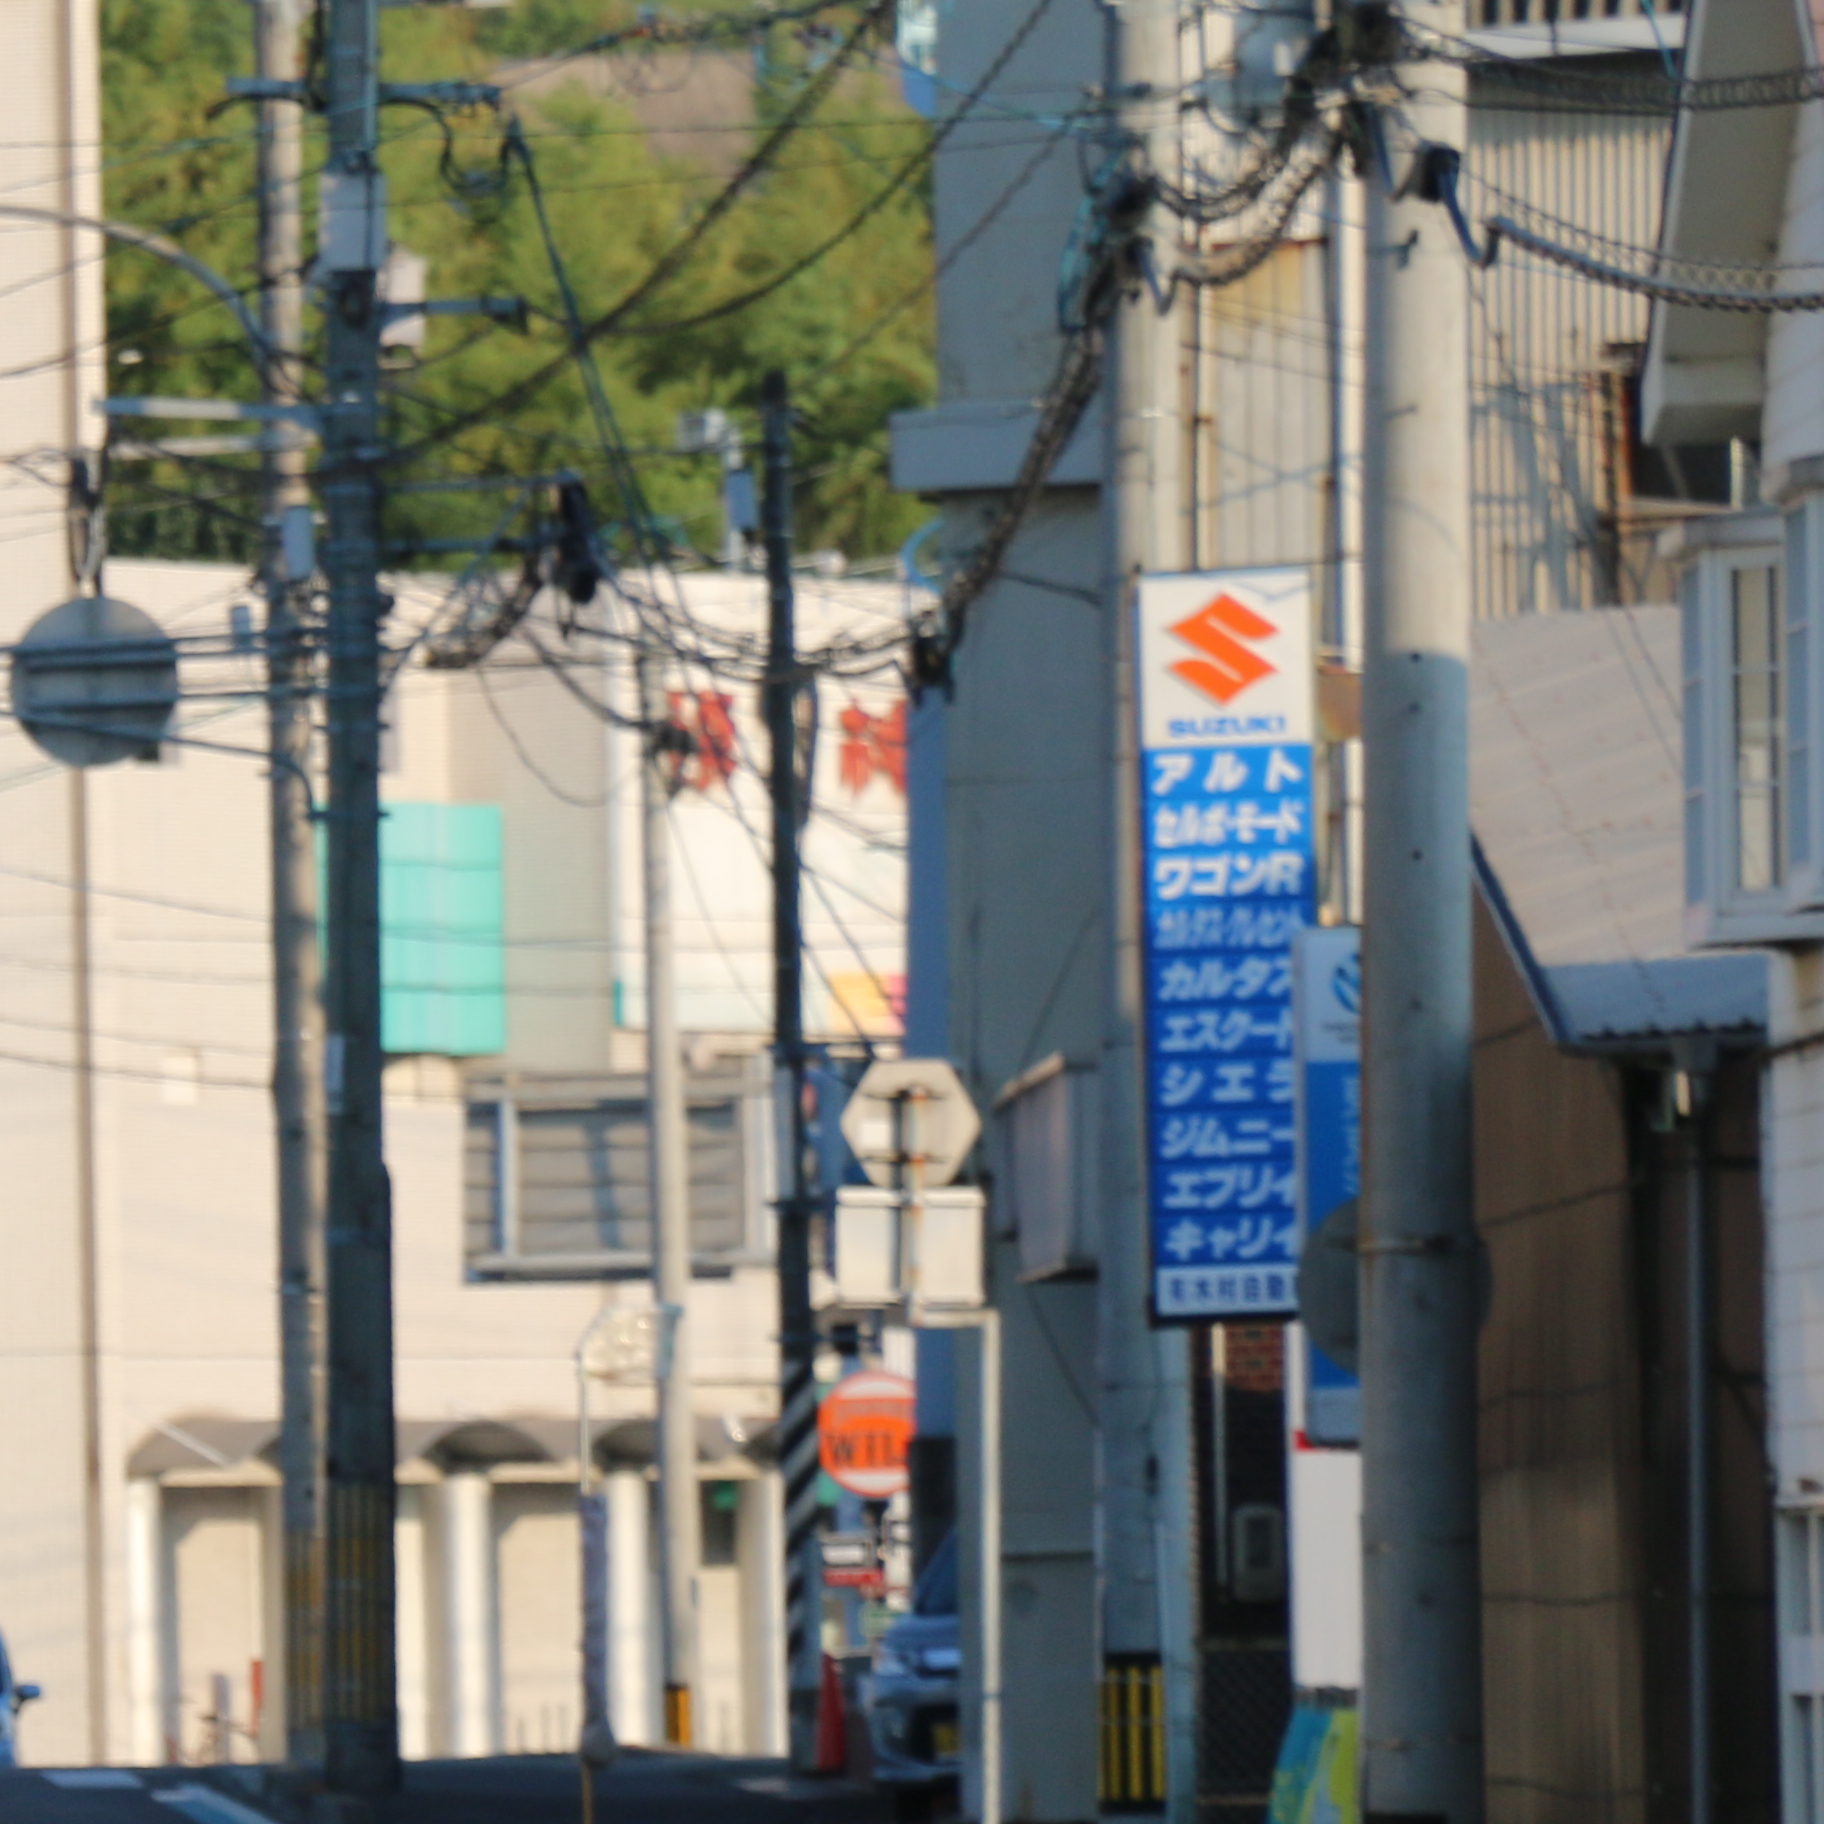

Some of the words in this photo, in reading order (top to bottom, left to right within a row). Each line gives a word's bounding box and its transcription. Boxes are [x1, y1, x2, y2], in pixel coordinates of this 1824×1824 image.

[1169, 716, 1286, 739] SUZUKI
[1153, 749, 1303, 796] アルト
[1154, 853, 1303, 900] ワゴンR
